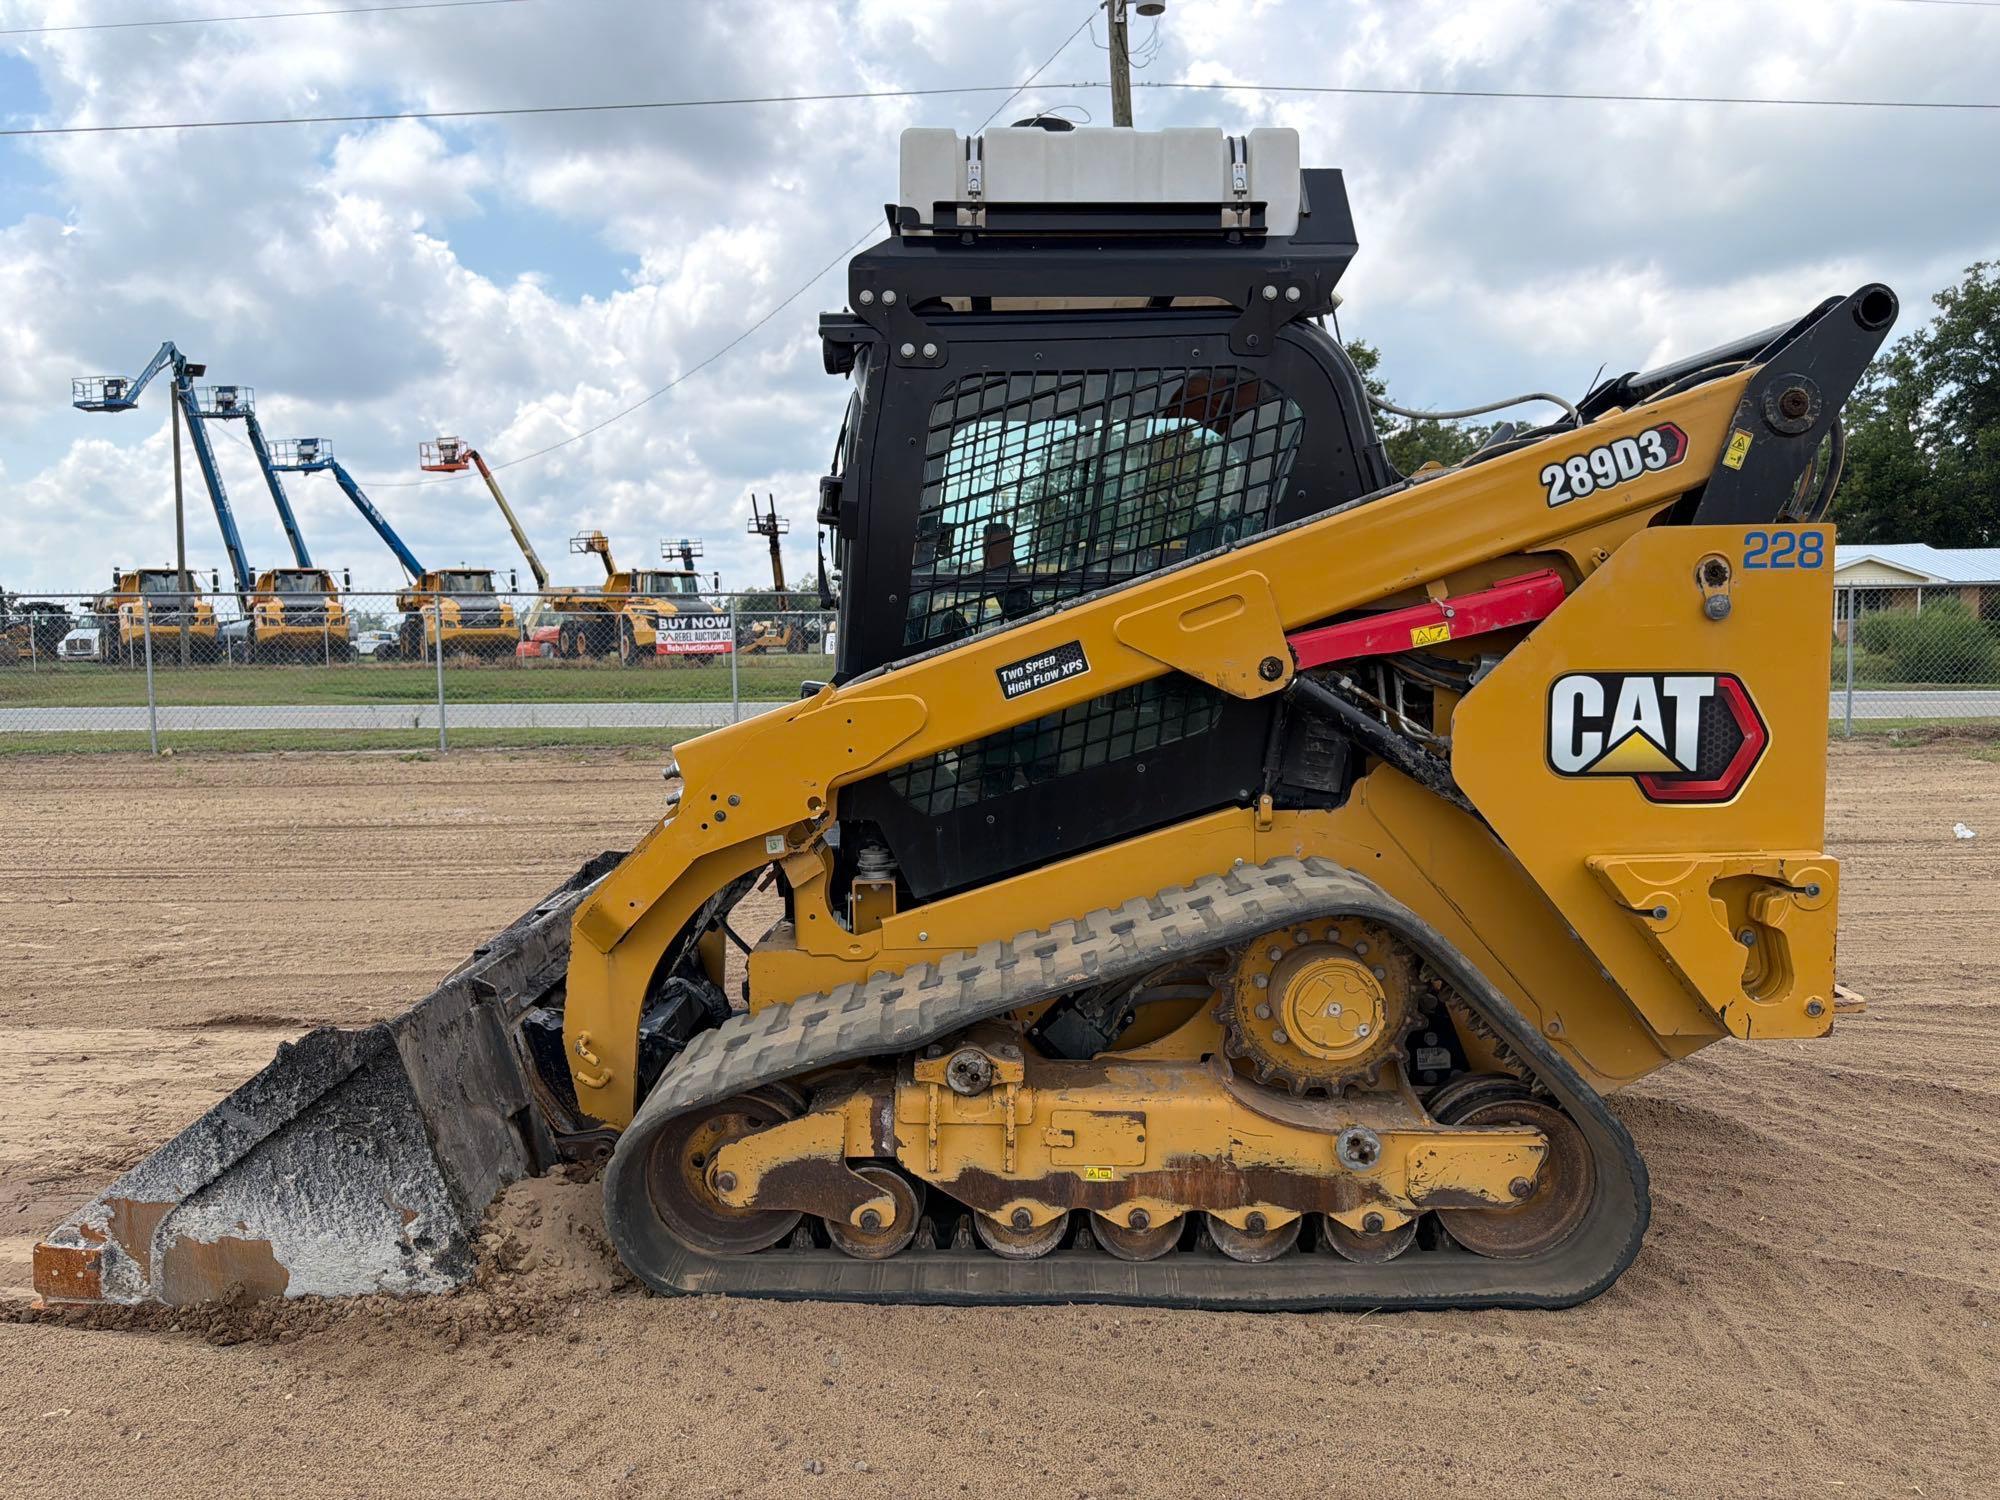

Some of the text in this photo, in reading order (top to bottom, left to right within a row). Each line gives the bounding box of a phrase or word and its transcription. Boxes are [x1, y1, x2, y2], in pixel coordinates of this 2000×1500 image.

[1541, 430, 1667, 506] 289D3
[1743, 531, 1824, 569] 228
[658, 616, 729, 630] BUY NOW
[674, 632, 693, 641] REBEL
[694, 631, 720, 641] AUCTION
[666, 644, 724, 652] RebelAuction.com
[1001, 655, 1056, 682] TWO SPEED
[1007, 658, 1083, 696] HIGH FLOW XPS
[1551, 675, 1715, 772] CAT
